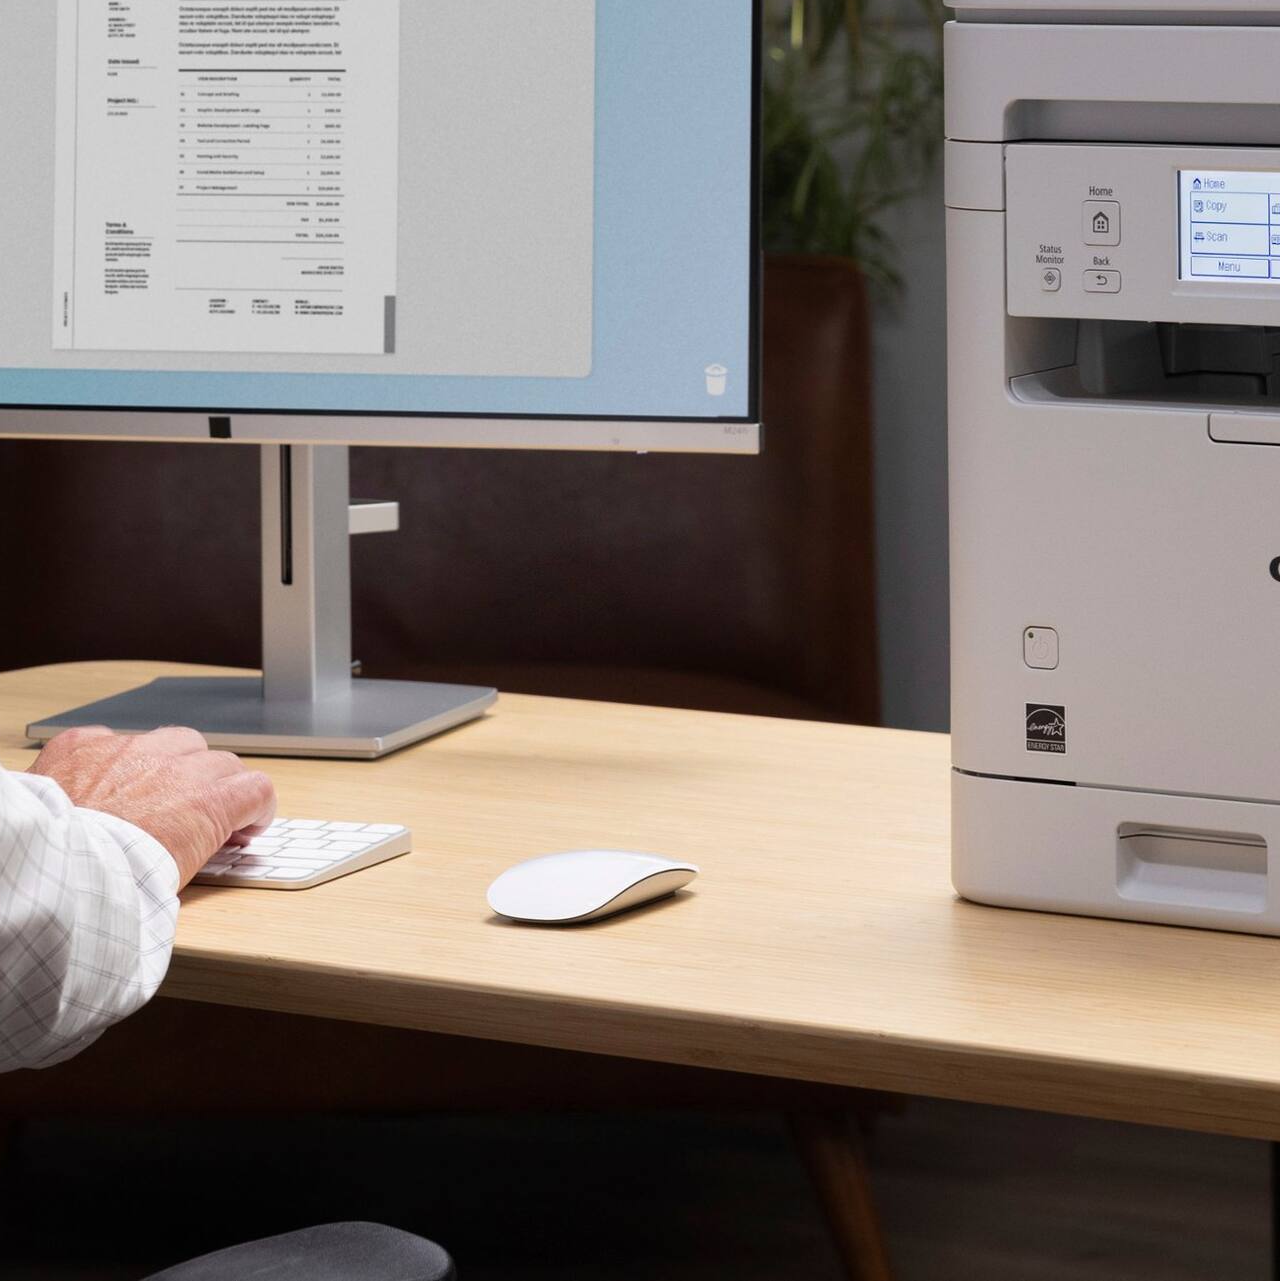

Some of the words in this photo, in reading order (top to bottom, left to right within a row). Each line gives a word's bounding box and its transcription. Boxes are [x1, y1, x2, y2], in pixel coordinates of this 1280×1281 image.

[1204, 178, 1226, 189] Home
[1089, 186, 1113, 196] Home
[1206, 201, 1227, 212] Copy
[1206, 232, 1228, 242] Scan
[1040, 244, 1062, 253] Status
[1036, 255, 1064, 264] Monitor
[1093, 256, 1110, 265] Back
[1218, 262, 1241, 272] Menu
[1028, 742, 1049, 750] ENERGY
